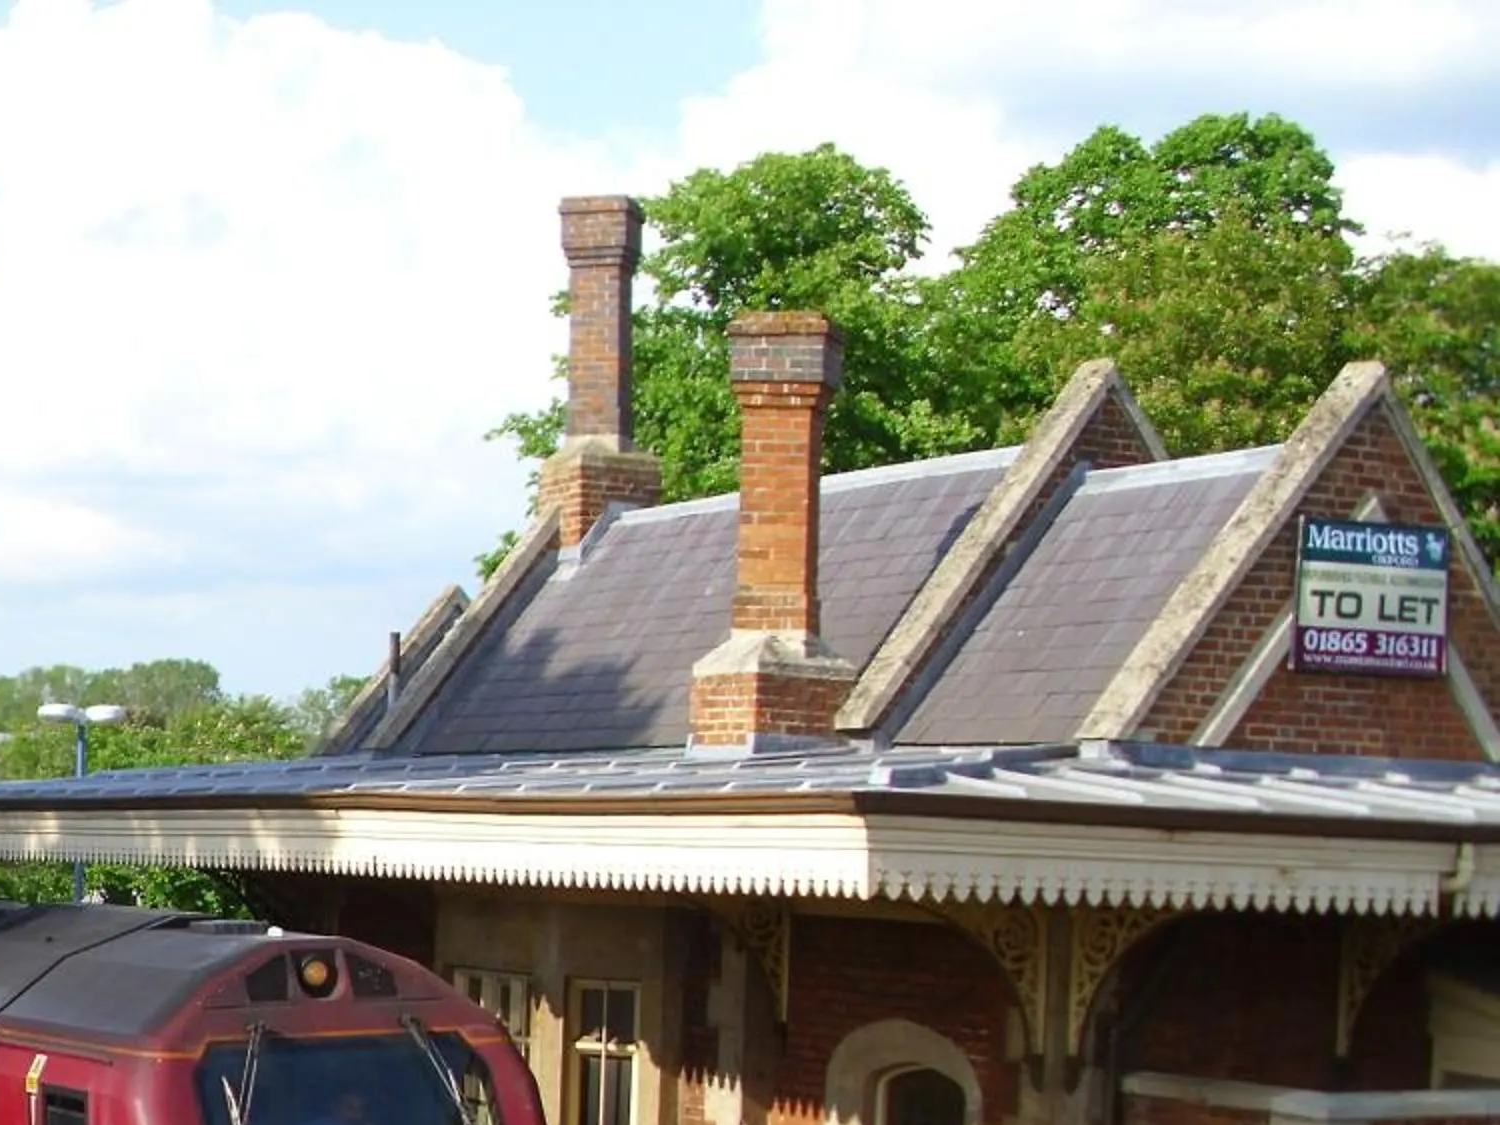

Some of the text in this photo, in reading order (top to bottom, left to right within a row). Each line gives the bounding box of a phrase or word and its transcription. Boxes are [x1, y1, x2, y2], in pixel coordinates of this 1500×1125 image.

[1307, 524, 1419, 556] Marriotts
[1310, 588, 1440, 625] TO LET
[1303, 629, 1438, 658] 01865 316311
